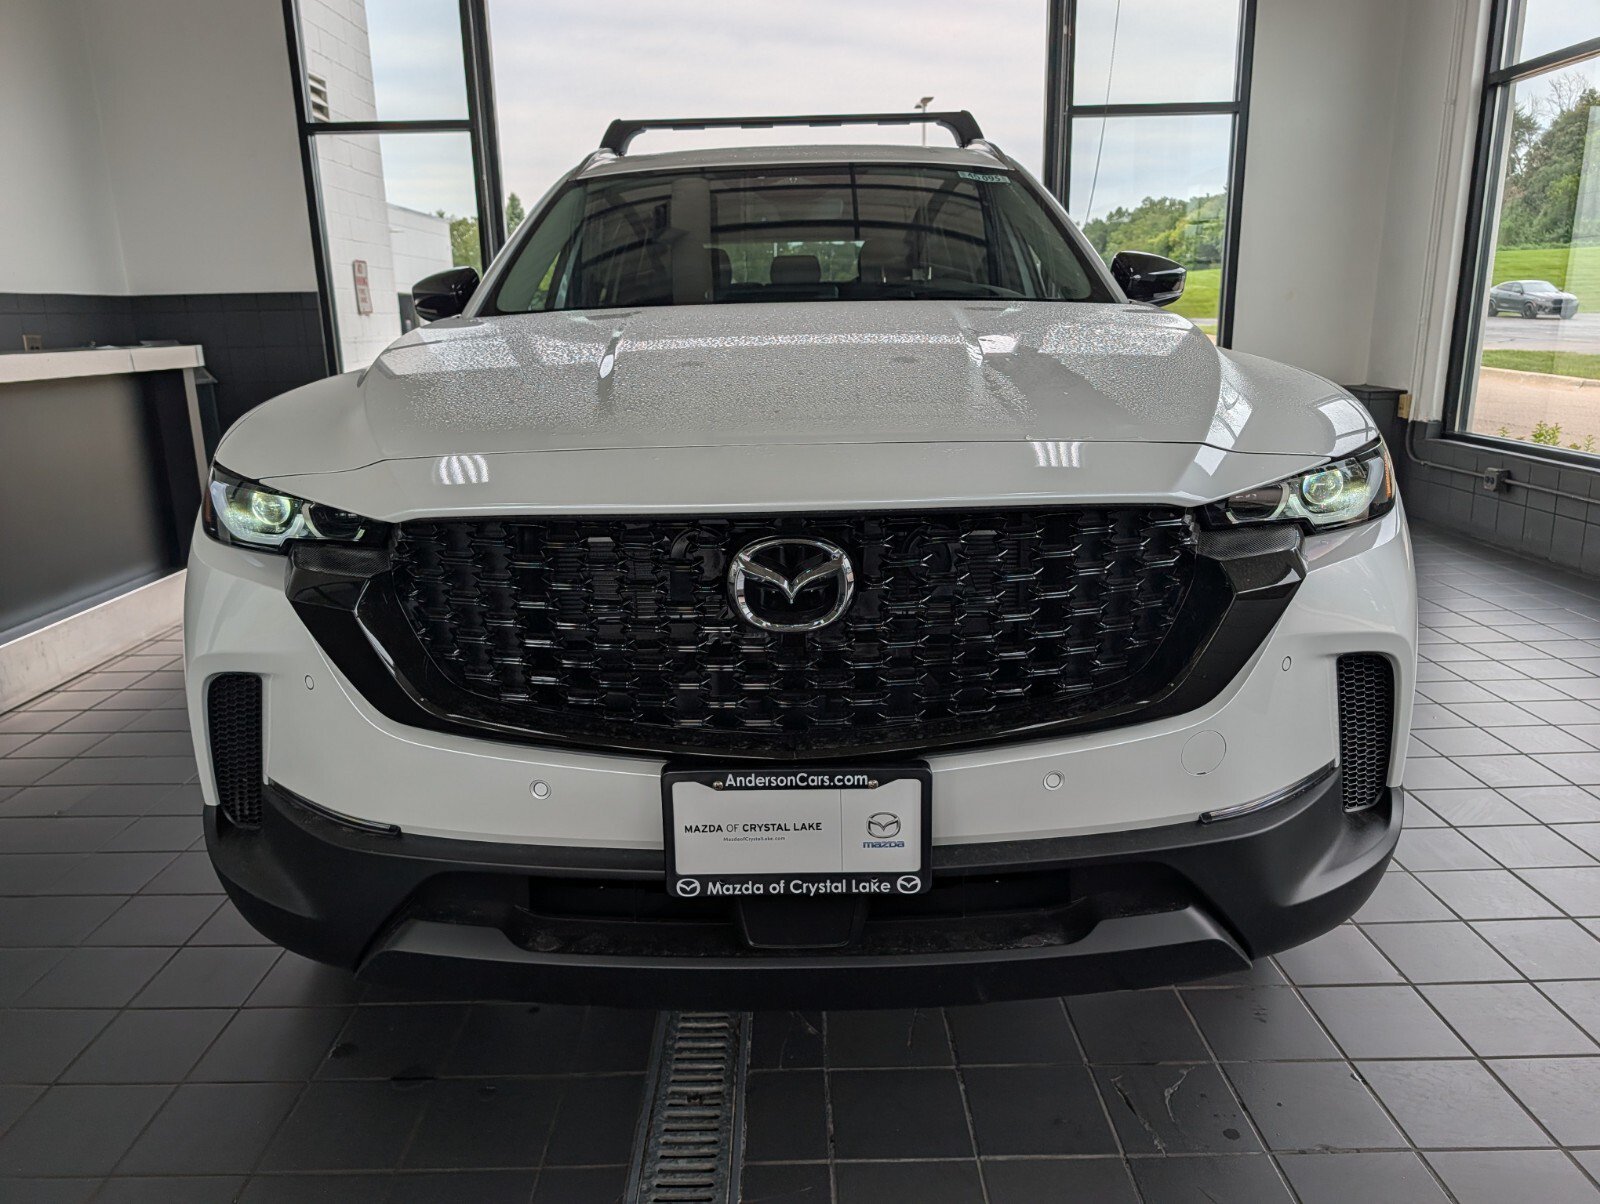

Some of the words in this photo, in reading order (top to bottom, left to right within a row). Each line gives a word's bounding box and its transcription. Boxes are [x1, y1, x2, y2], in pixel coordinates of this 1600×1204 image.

[725, 773, 868, 788] AndersonCars.com
[684, 824, 723, 834] MAZDA
[726, 823, 740, 833] OF
[742, 822, 790, 832] CRYSTAL
[793, 822, 823, 831] LAKE
[707, 880, 764, 895] Mazda
[769, 879, 785, 894] of
[790, 878, 847, 896] Crystal
[852, 878, 891, 893] Lake
